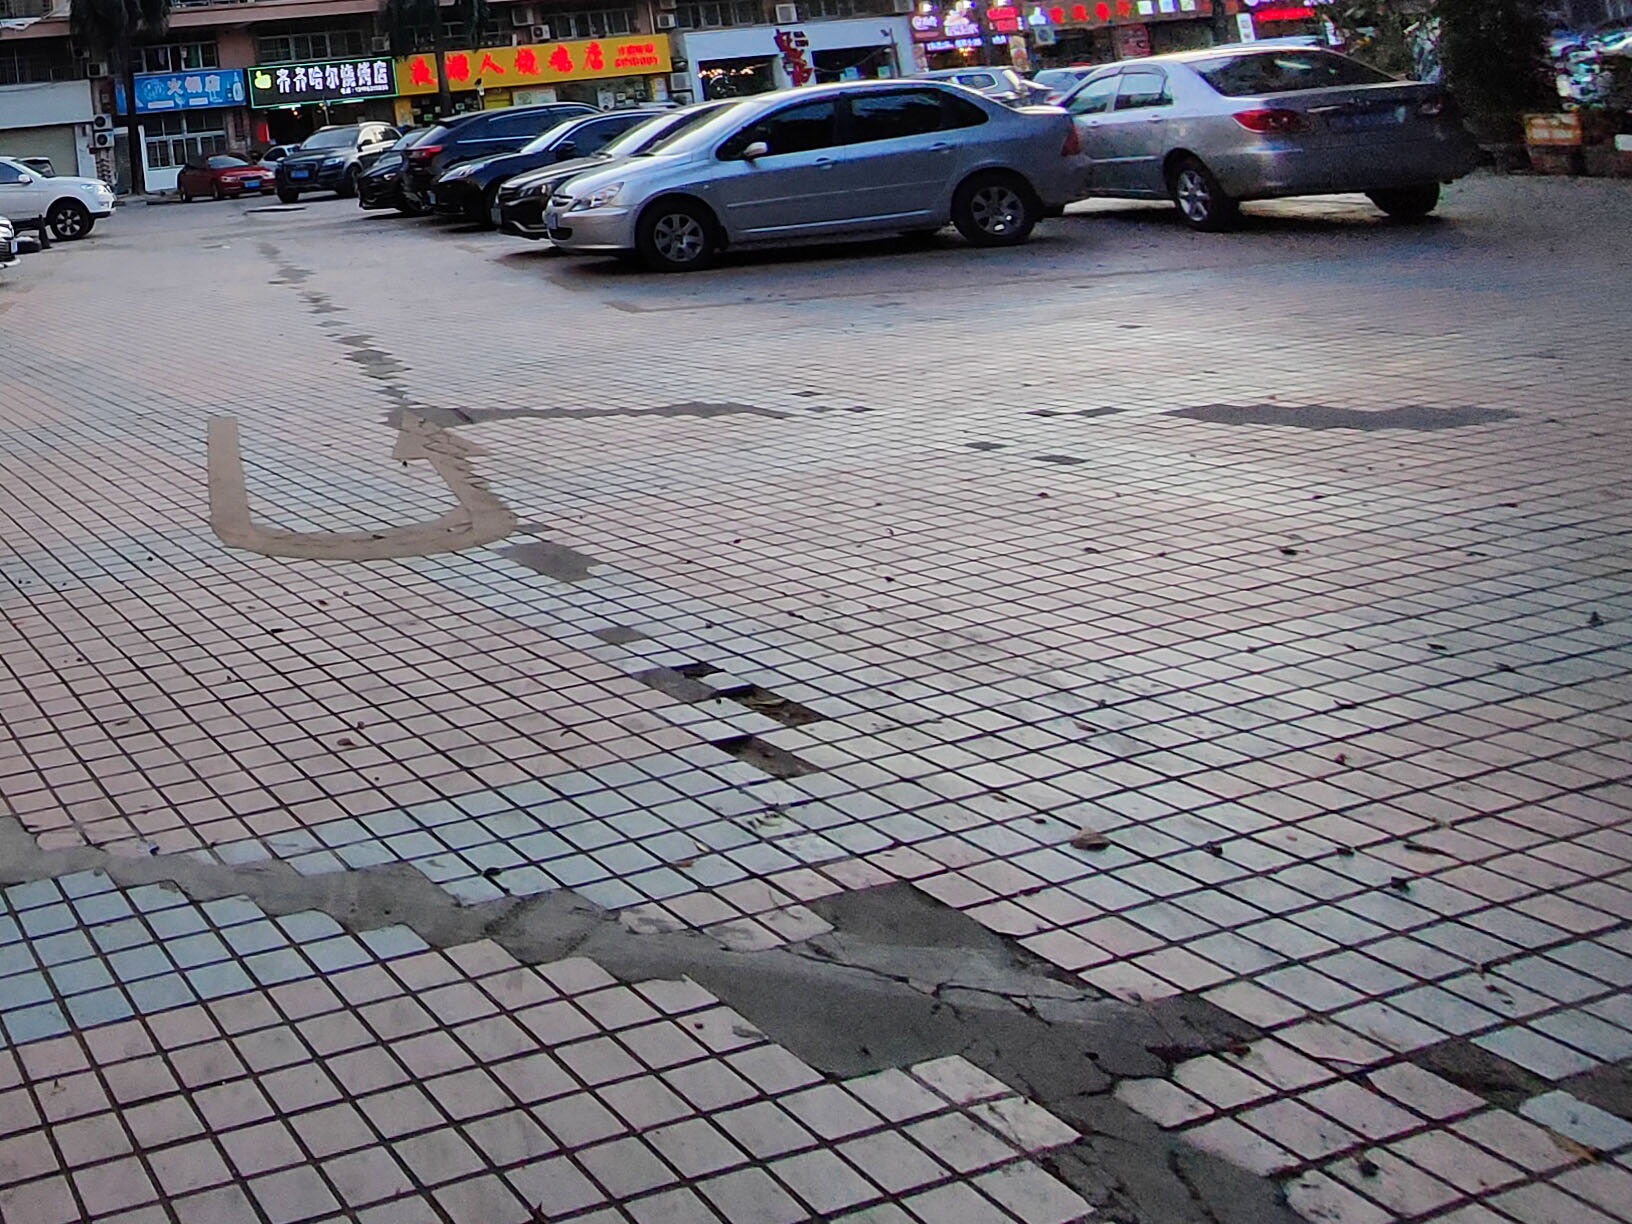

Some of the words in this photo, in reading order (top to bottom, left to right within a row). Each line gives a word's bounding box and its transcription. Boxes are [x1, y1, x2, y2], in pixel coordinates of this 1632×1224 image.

[276, 60, 388, 93] 齐齐哈尔烧烤店
